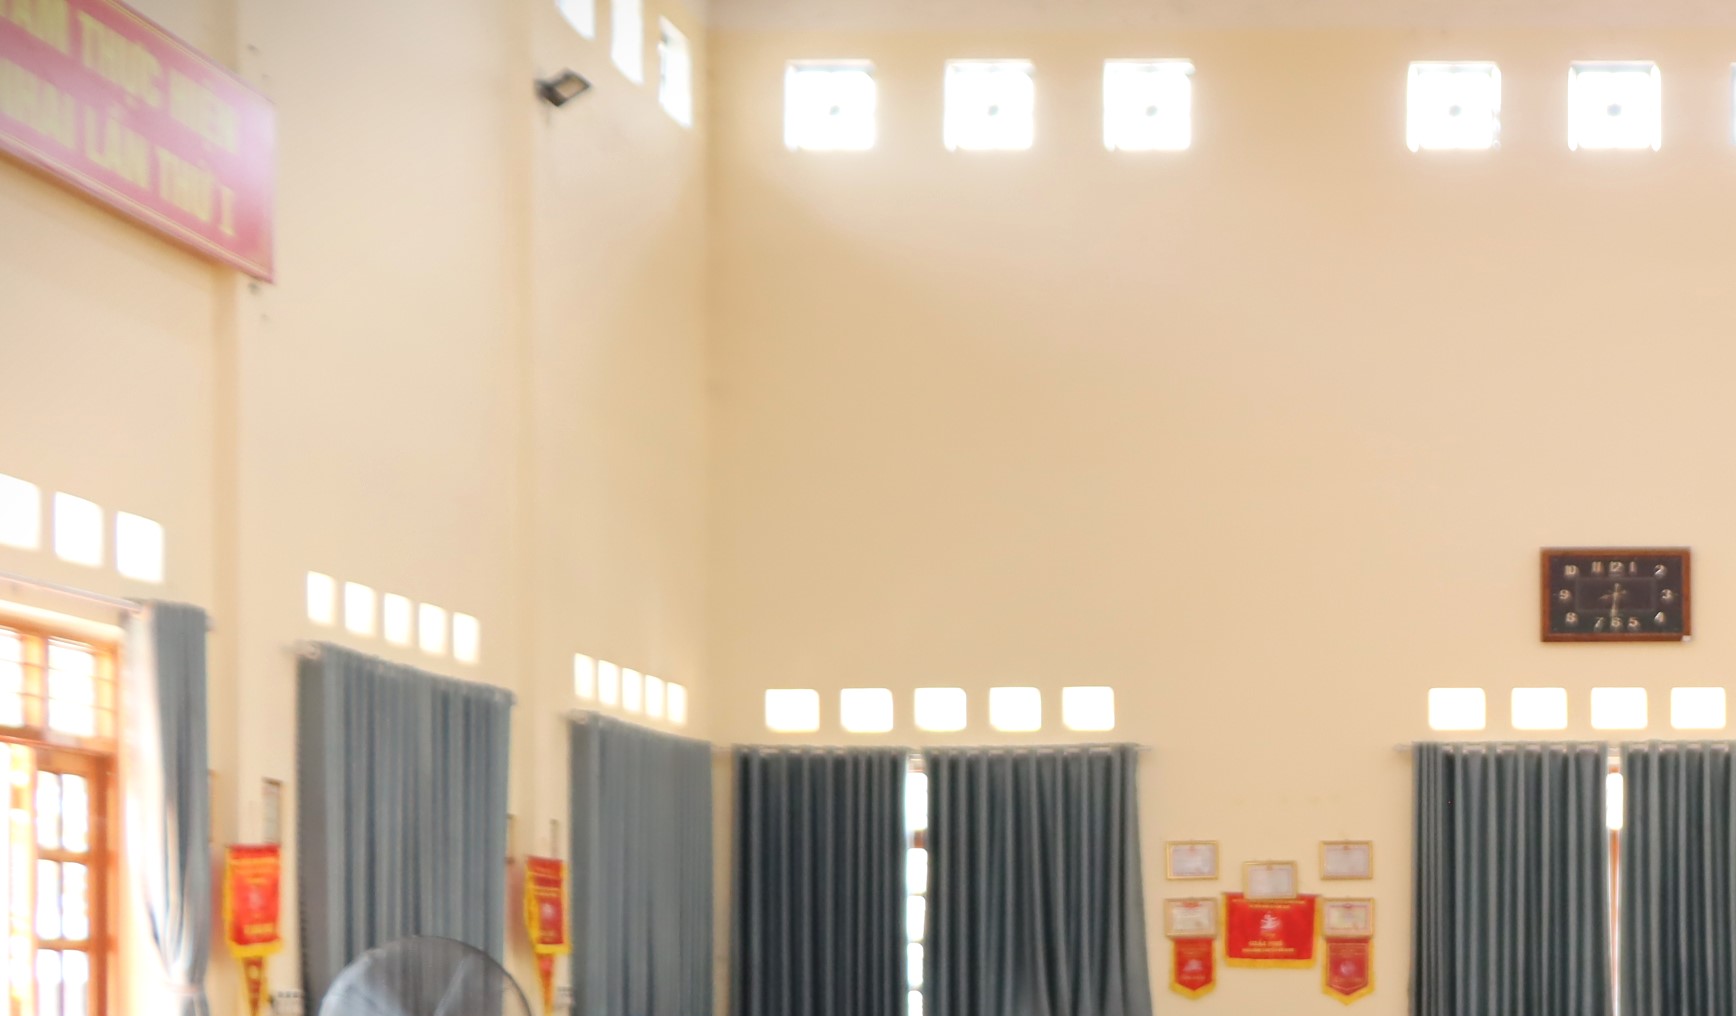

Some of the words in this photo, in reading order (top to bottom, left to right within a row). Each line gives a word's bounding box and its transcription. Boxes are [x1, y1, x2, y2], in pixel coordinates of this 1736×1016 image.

[1609, 560, 1624, 572] 12
[1655, 564, 1667, 576] 2
[1559, 589, 1571, 601] 9
[1661, 589, 1673, 600] 3
[1594, 617, 1604, 629] 7
[1628, 617, 1640, 628] 5
[1654, 611, 1665, 623] 4
